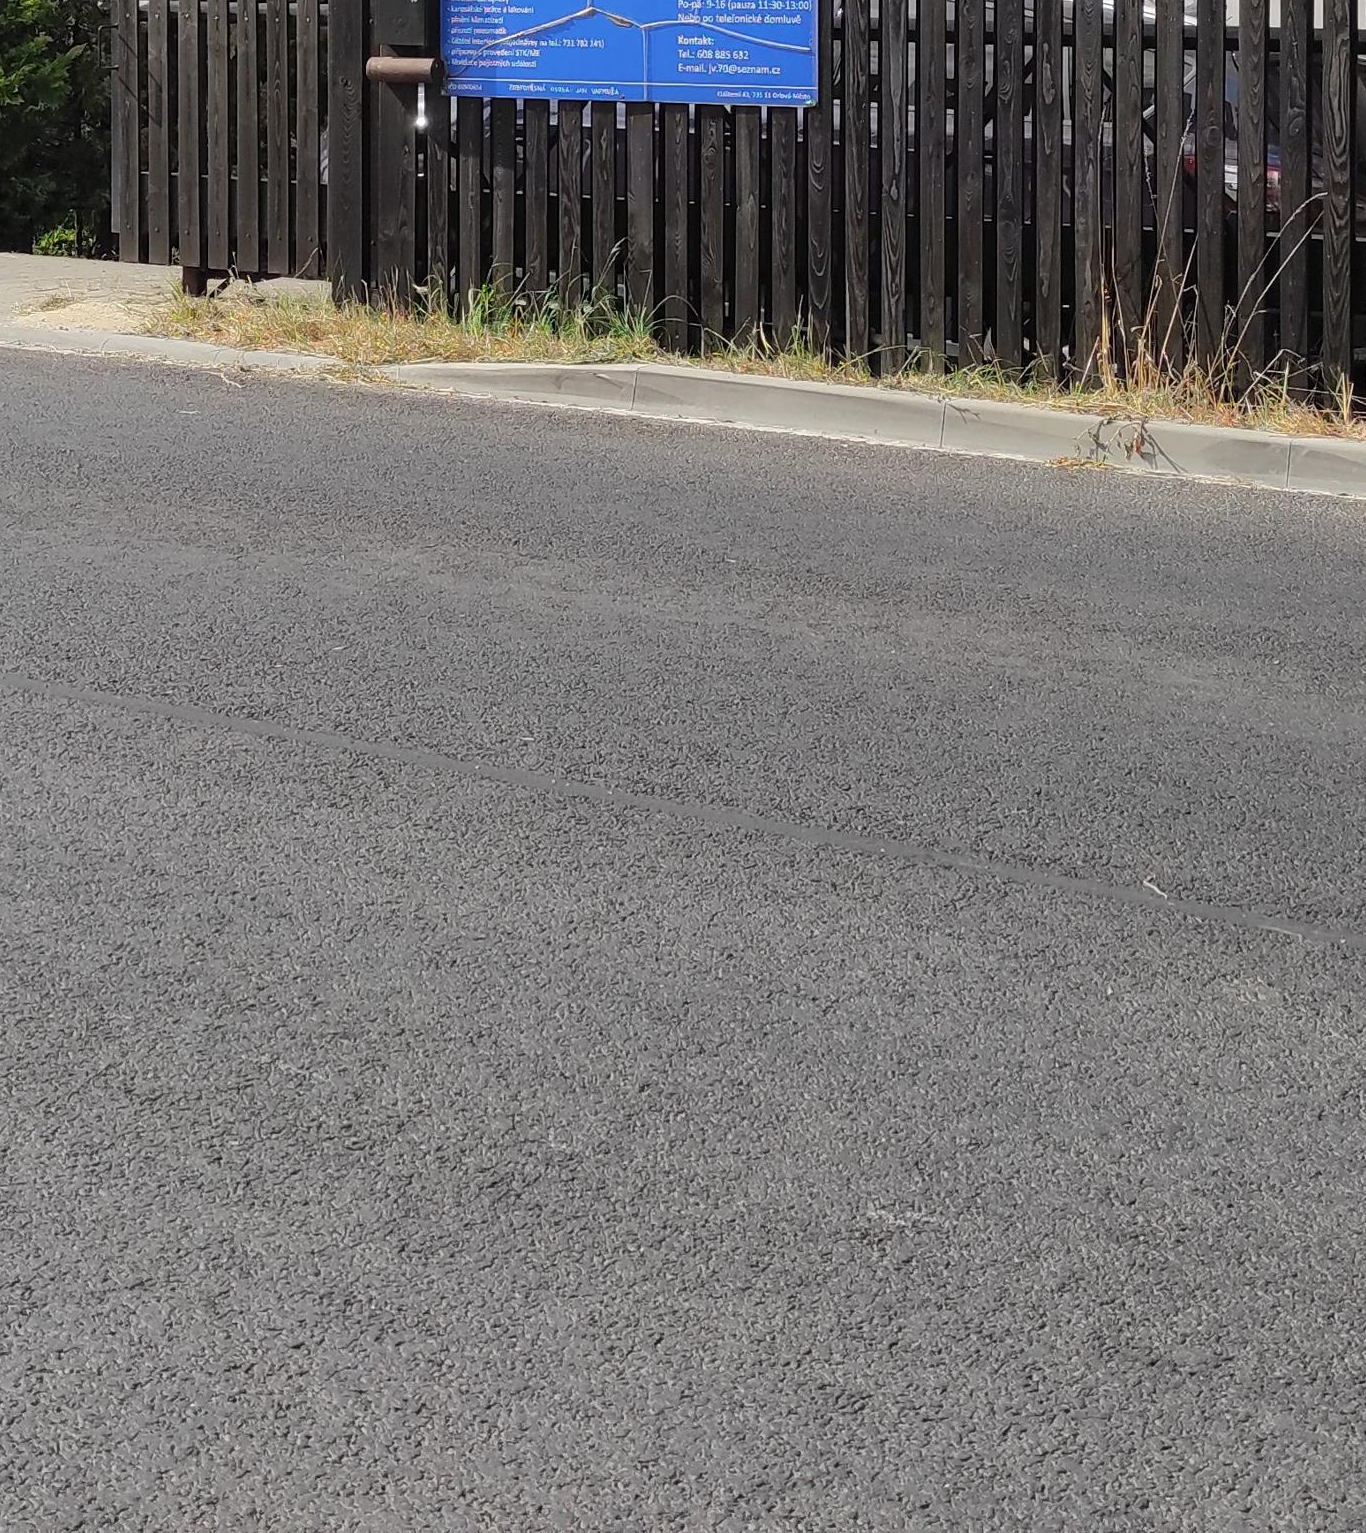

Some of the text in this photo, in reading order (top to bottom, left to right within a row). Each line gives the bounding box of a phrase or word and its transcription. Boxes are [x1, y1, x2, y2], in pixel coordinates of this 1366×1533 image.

[706, 0, 726, 10] 9-16
[715, 14, 763, 24] telefonické
[764, 14, 802, 24] domluvě
[677, 34, 715, 46] Kontakt:
